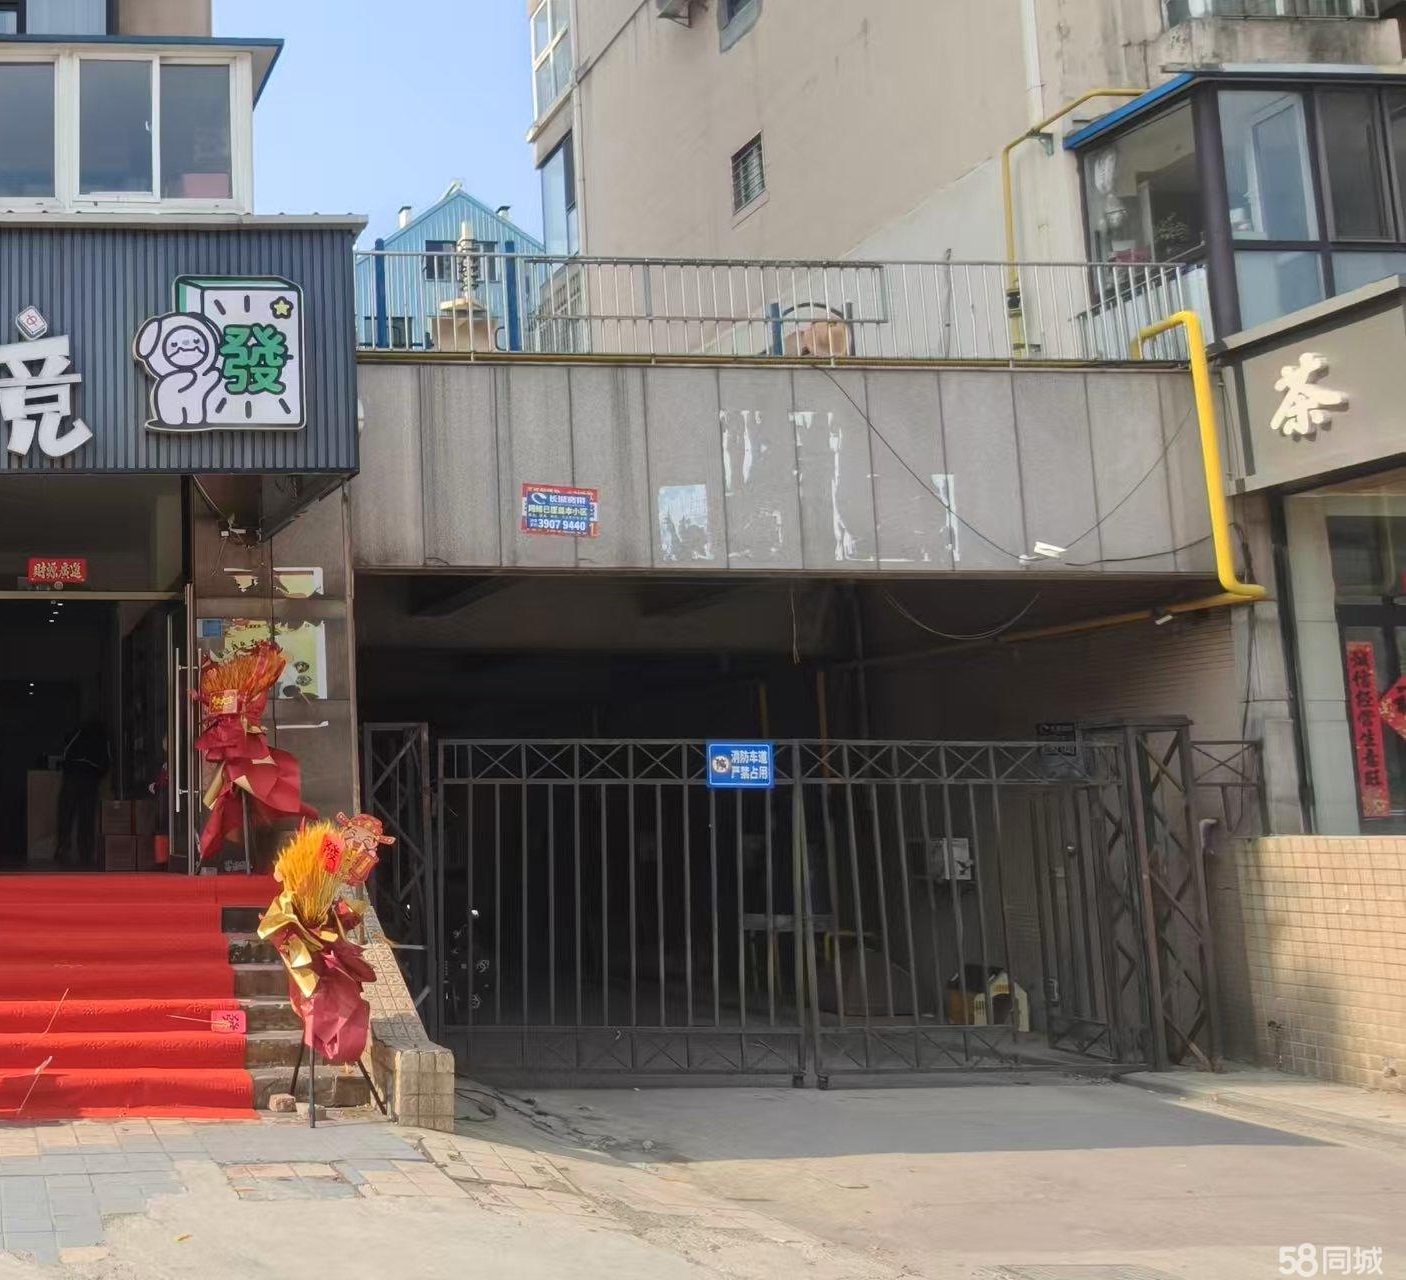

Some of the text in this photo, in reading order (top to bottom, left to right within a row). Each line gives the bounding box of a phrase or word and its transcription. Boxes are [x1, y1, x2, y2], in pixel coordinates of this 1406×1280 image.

[220, 322, 290, 395] 發
[1270, 351, 1350, 437] 茶
[538, 518, 561, 529] 3907
[562, 520, 586, 531] 9440
[731, 750, 768, 764] 消防车道
[731, 766, 768, 780] 严禁占用
